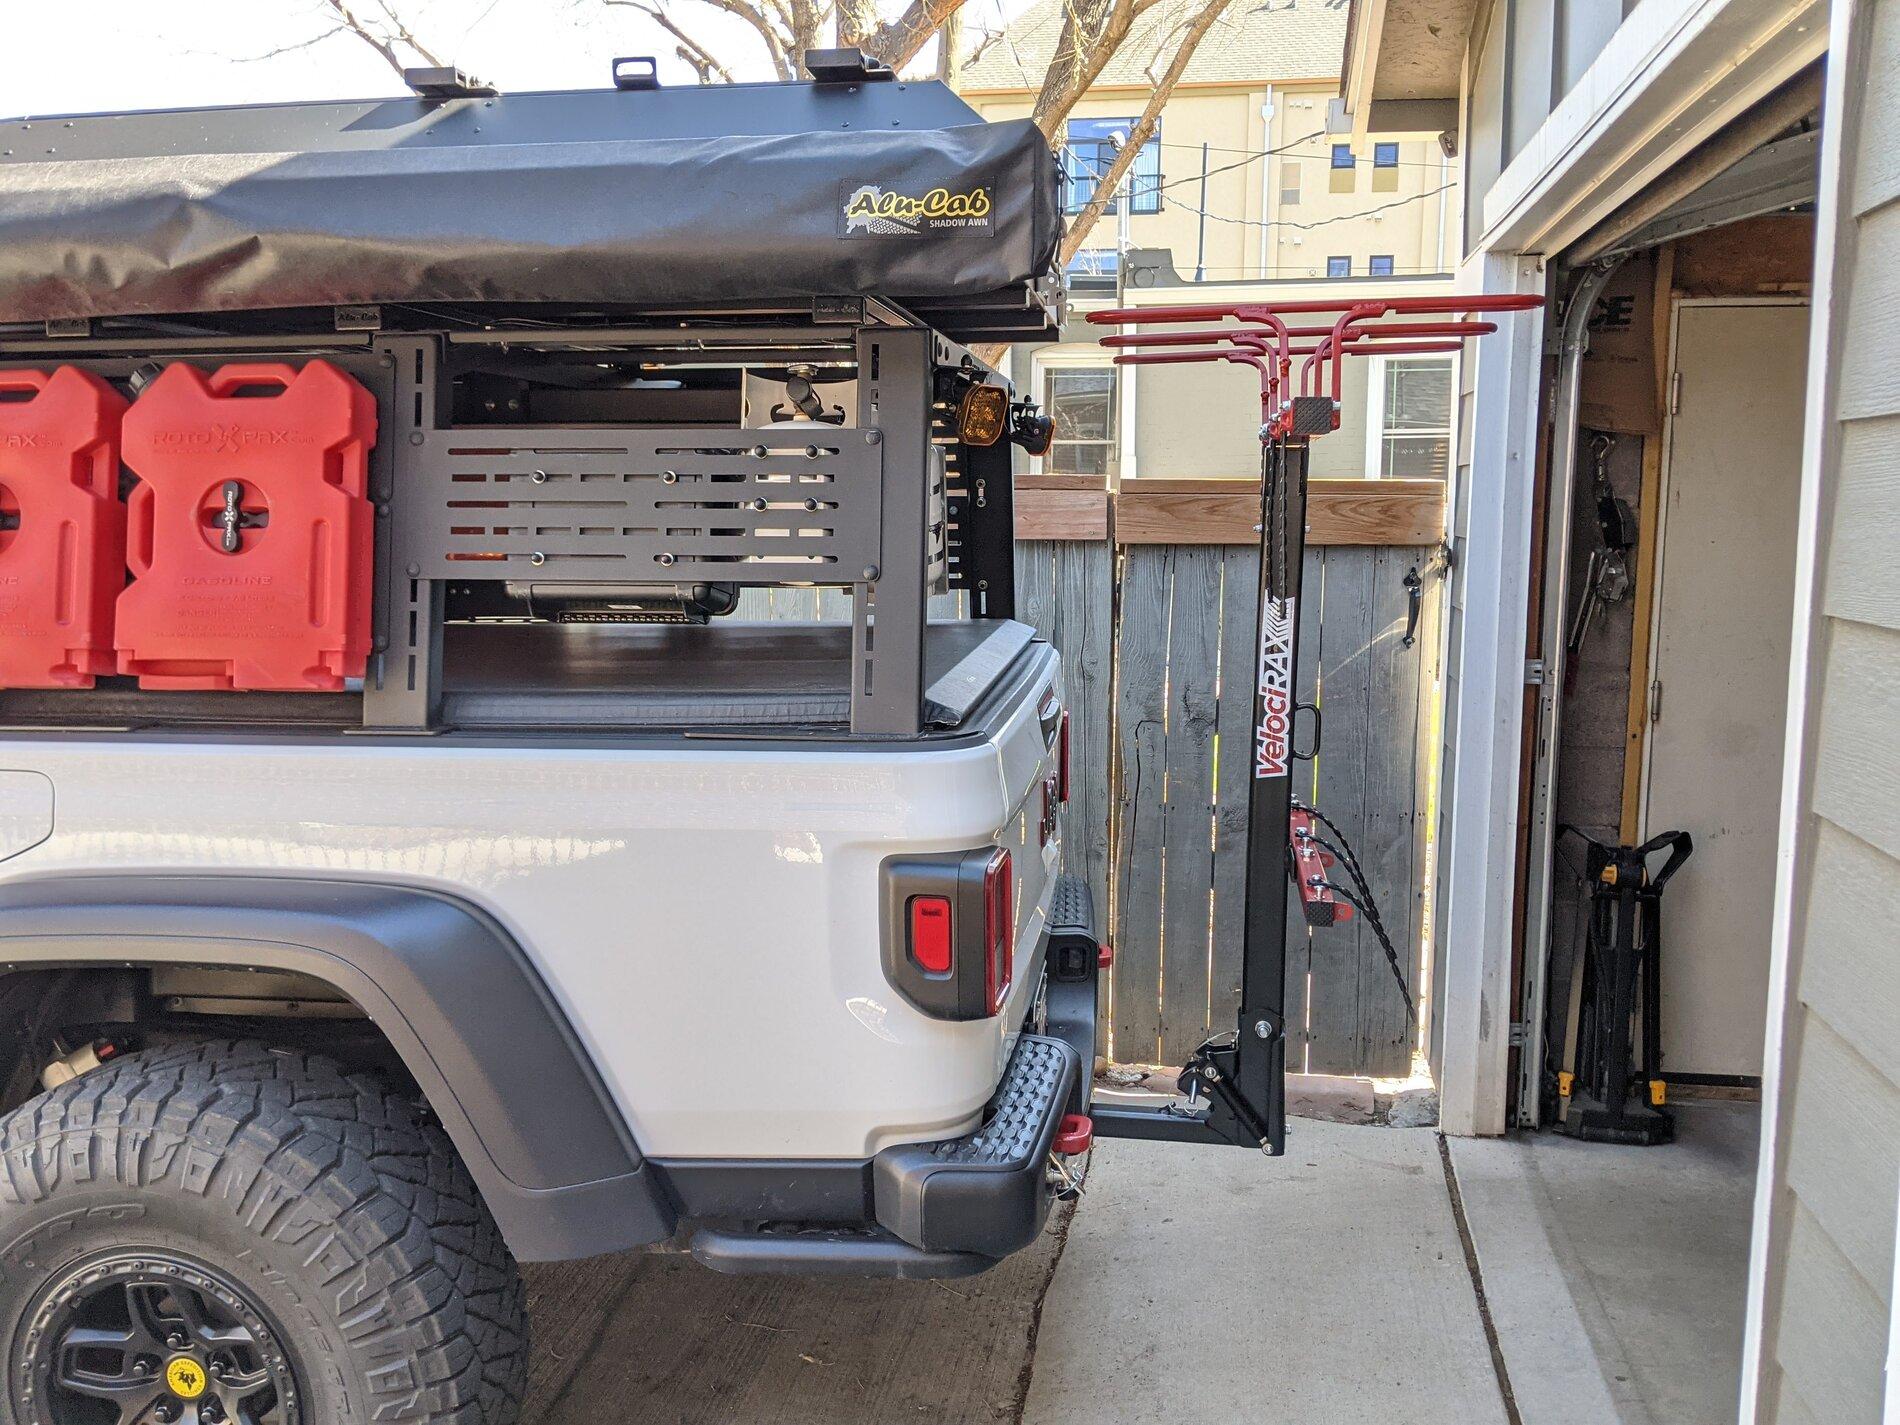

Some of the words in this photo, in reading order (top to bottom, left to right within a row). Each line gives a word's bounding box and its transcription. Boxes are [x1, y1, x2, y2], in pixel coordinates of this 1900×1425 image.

[848, 188, 991, 218] Alu-Cab
[929, 219, 966, 228] SHADOW
[967, 218, 989, 227] AWN
[1257, 590, 1296, 777] VelociRAX
